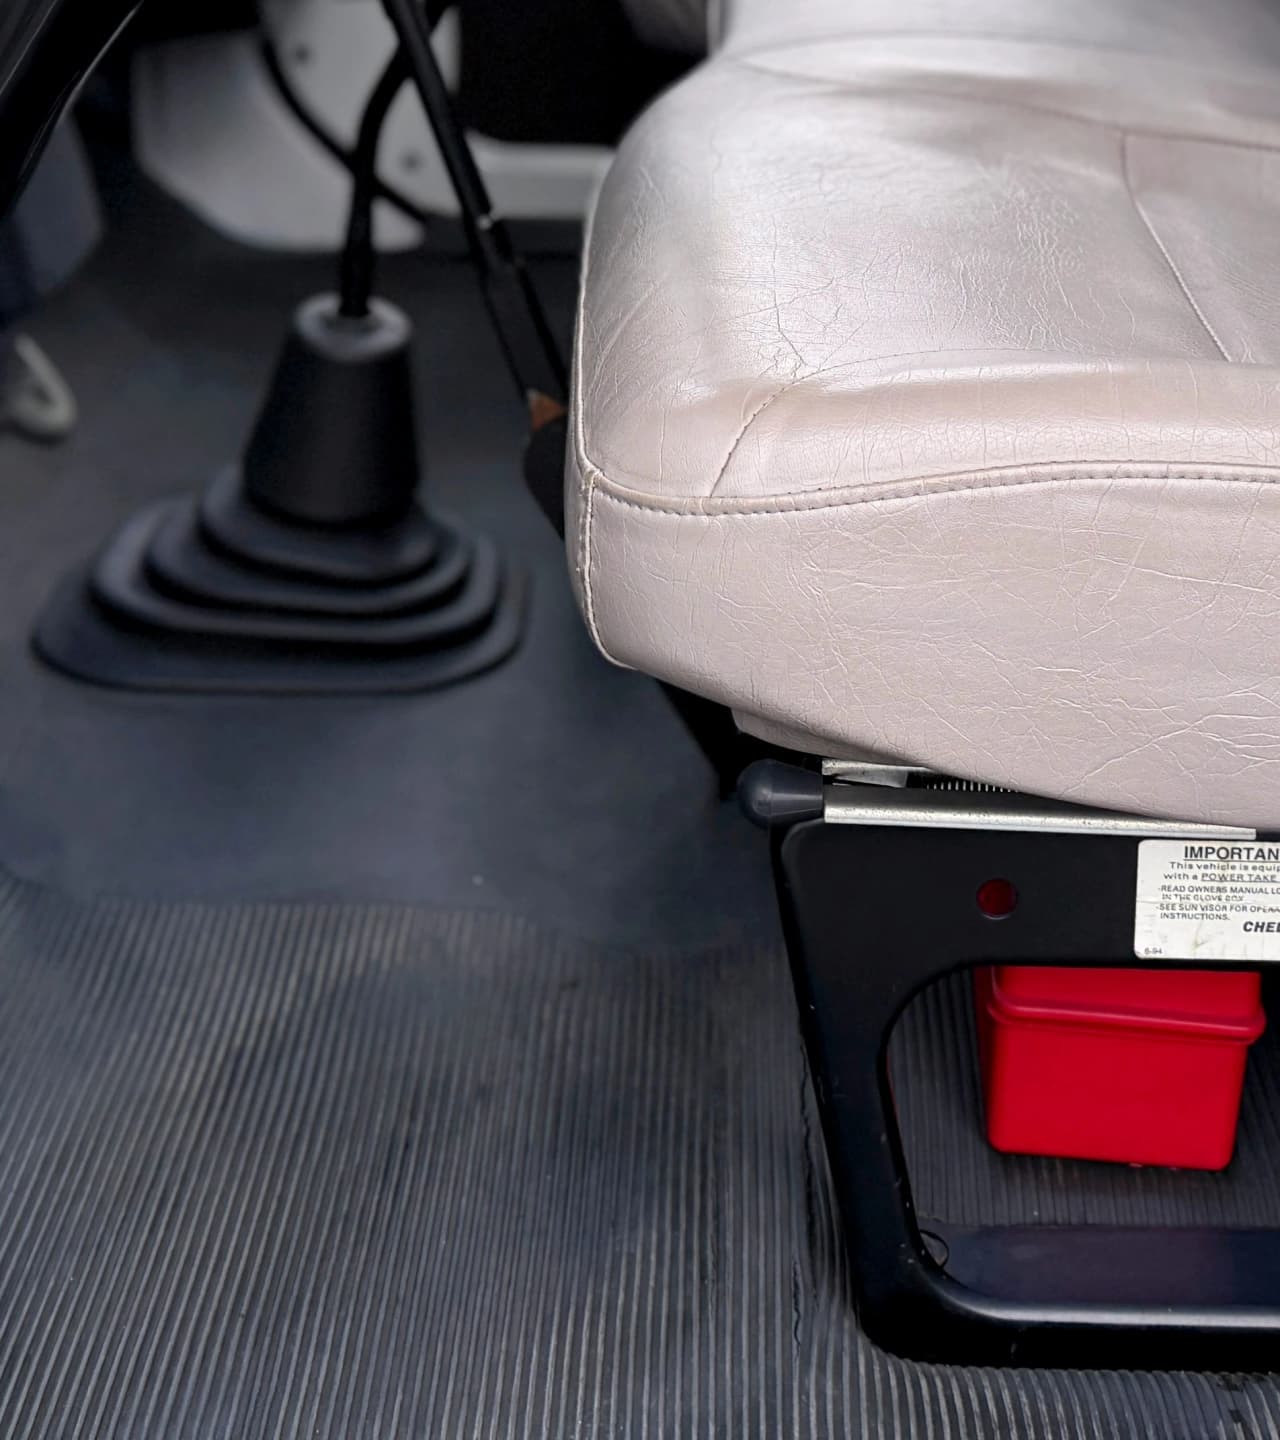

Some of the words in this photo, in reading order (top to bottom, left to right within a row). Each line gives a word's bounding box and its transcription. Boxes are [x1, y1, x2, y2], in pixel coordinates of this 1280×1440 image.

[1169, 862, 1193, 870] This
[1196, 862, 1237, 871] vehicle
[1240, 863, 1249, 871] is
[1201, 873, 1244, 881] POWER
[1188, 885, 1227, 893] OWNERS
[1230, 886, 1269, 894] MANUAL
[1179, 903, 1198, 911] SUN
[1200, 904, 1227, 912] VISOR
[1160, 912, 1231, 920] INSTRUCTIONS.
